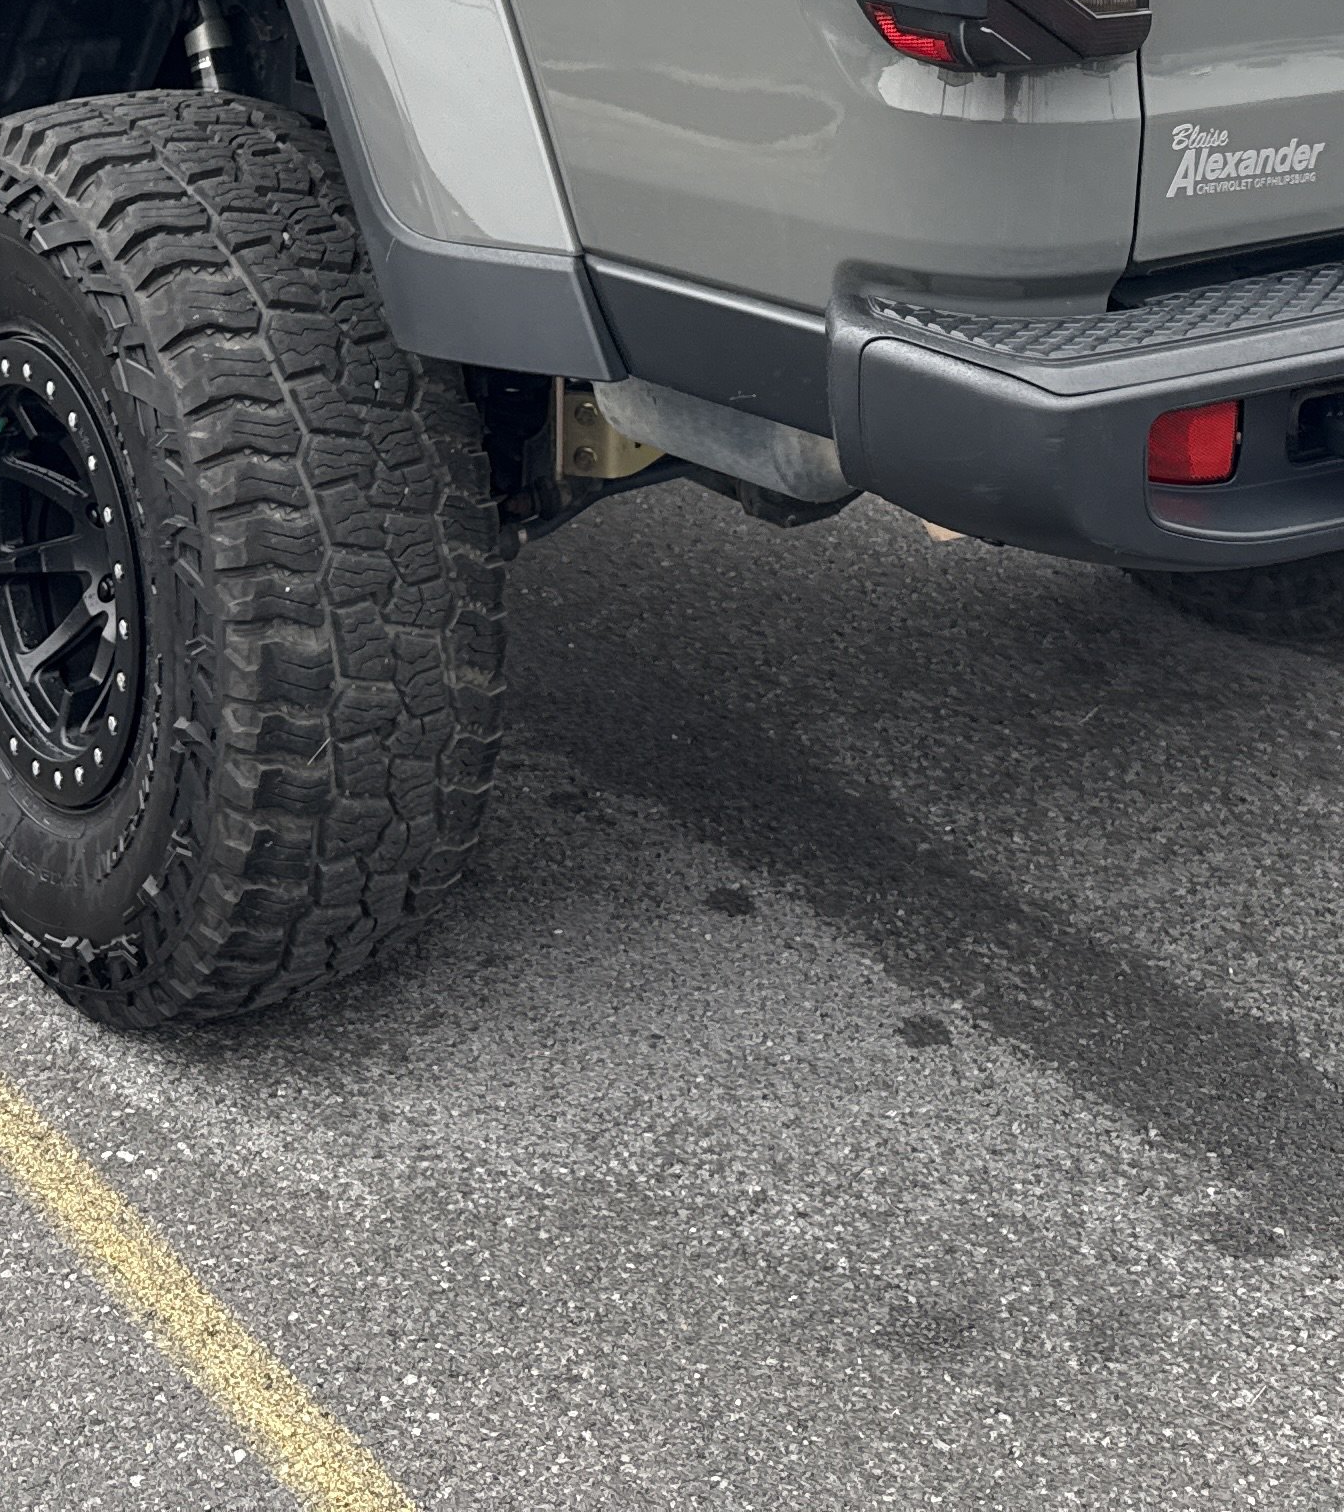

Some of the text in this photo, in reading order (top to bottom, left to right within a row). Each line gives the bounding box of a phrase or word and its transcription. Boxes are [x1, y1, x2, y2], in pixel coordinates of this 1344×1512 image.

[1172, 124, 1228, 150] Blaise
[1166, 138, 1326, 197] Alexander
[1196, 179, 1253, 194] CHEVROLET
[1254, 178, 1266, 188] OF
